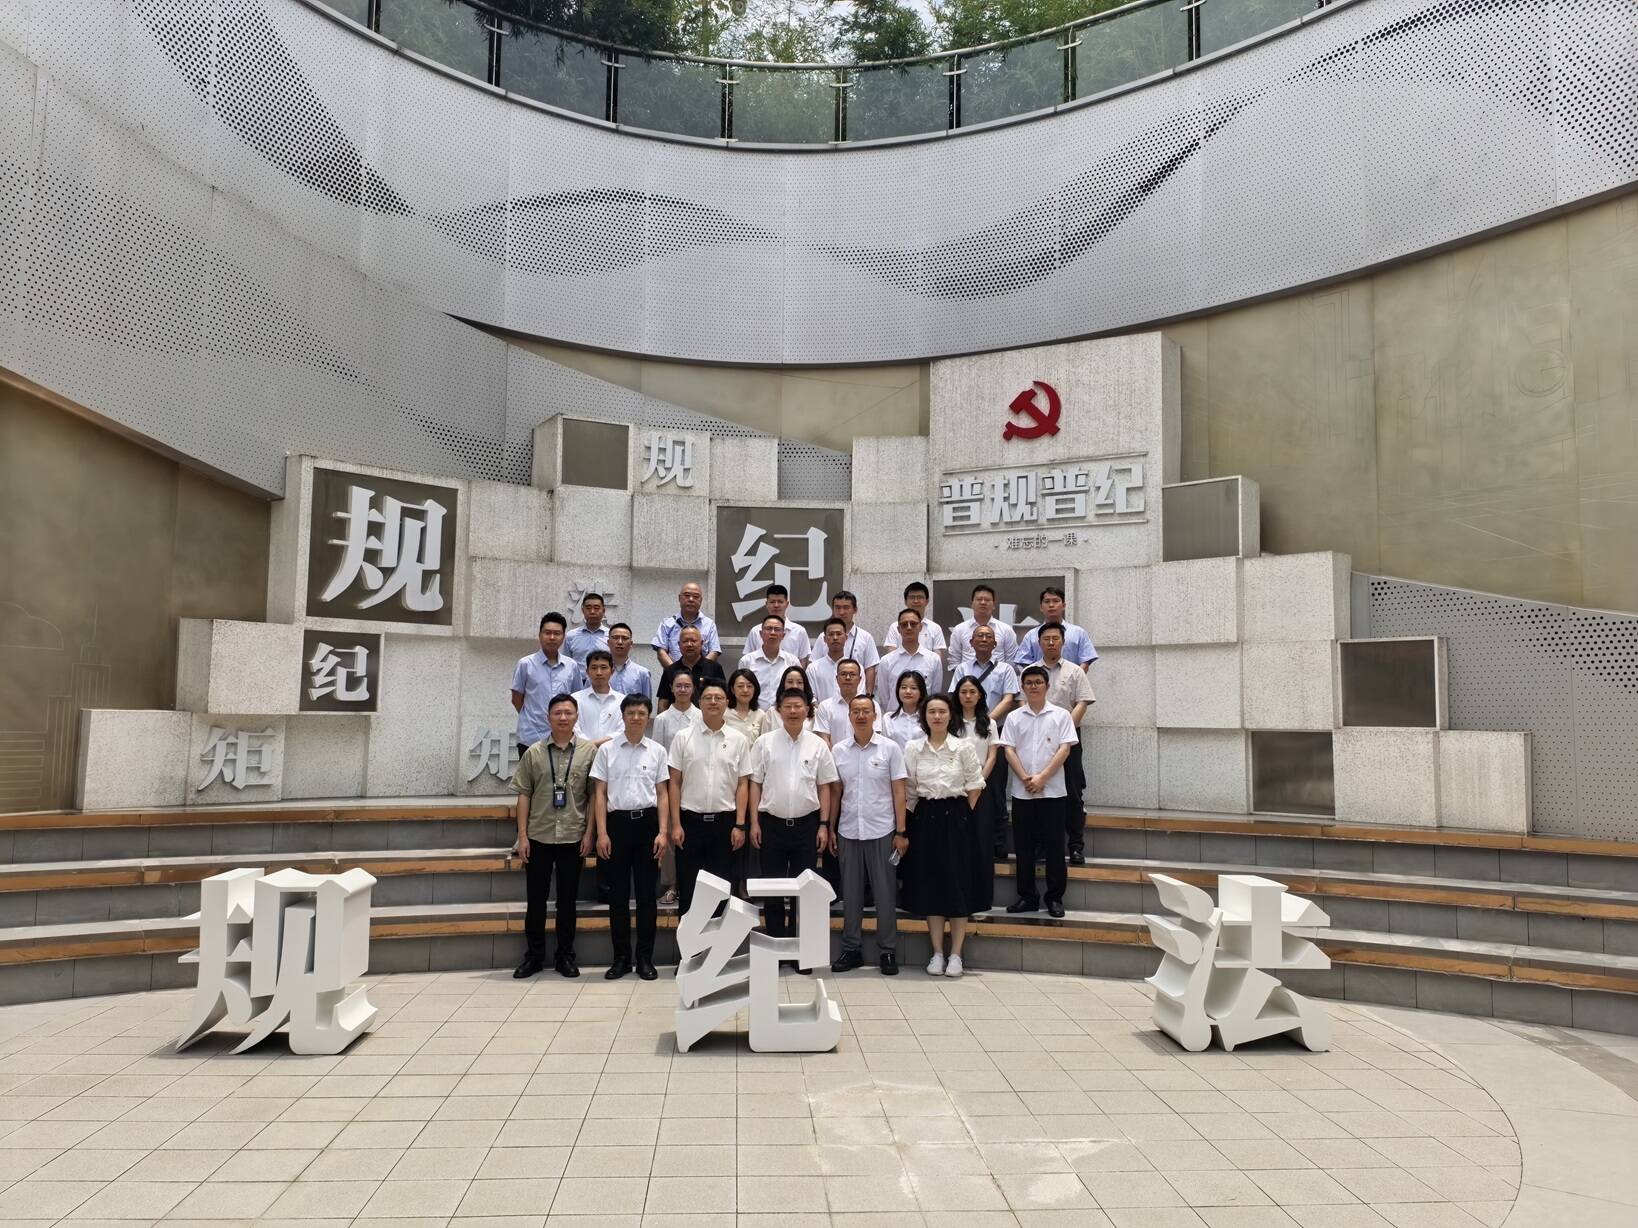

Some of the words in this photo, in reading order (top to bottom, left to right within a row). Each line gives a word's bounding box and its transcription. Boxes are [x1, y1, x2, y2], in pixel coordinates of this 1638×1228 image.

[641, 432, 696, 488] 规
[320, 485, 448, 612] 规
[730, 524, 833, 622] 纪
[1007, 532, 1078, 550] 难忘的一课
[308, 641, 371, 702] 纪
[198, 725, 278, 791] 矩
[176, 867, 378, 1055] 规
[675, 868, 843, 1053] 纪
[1143, 873, 1332, 1052] 法
